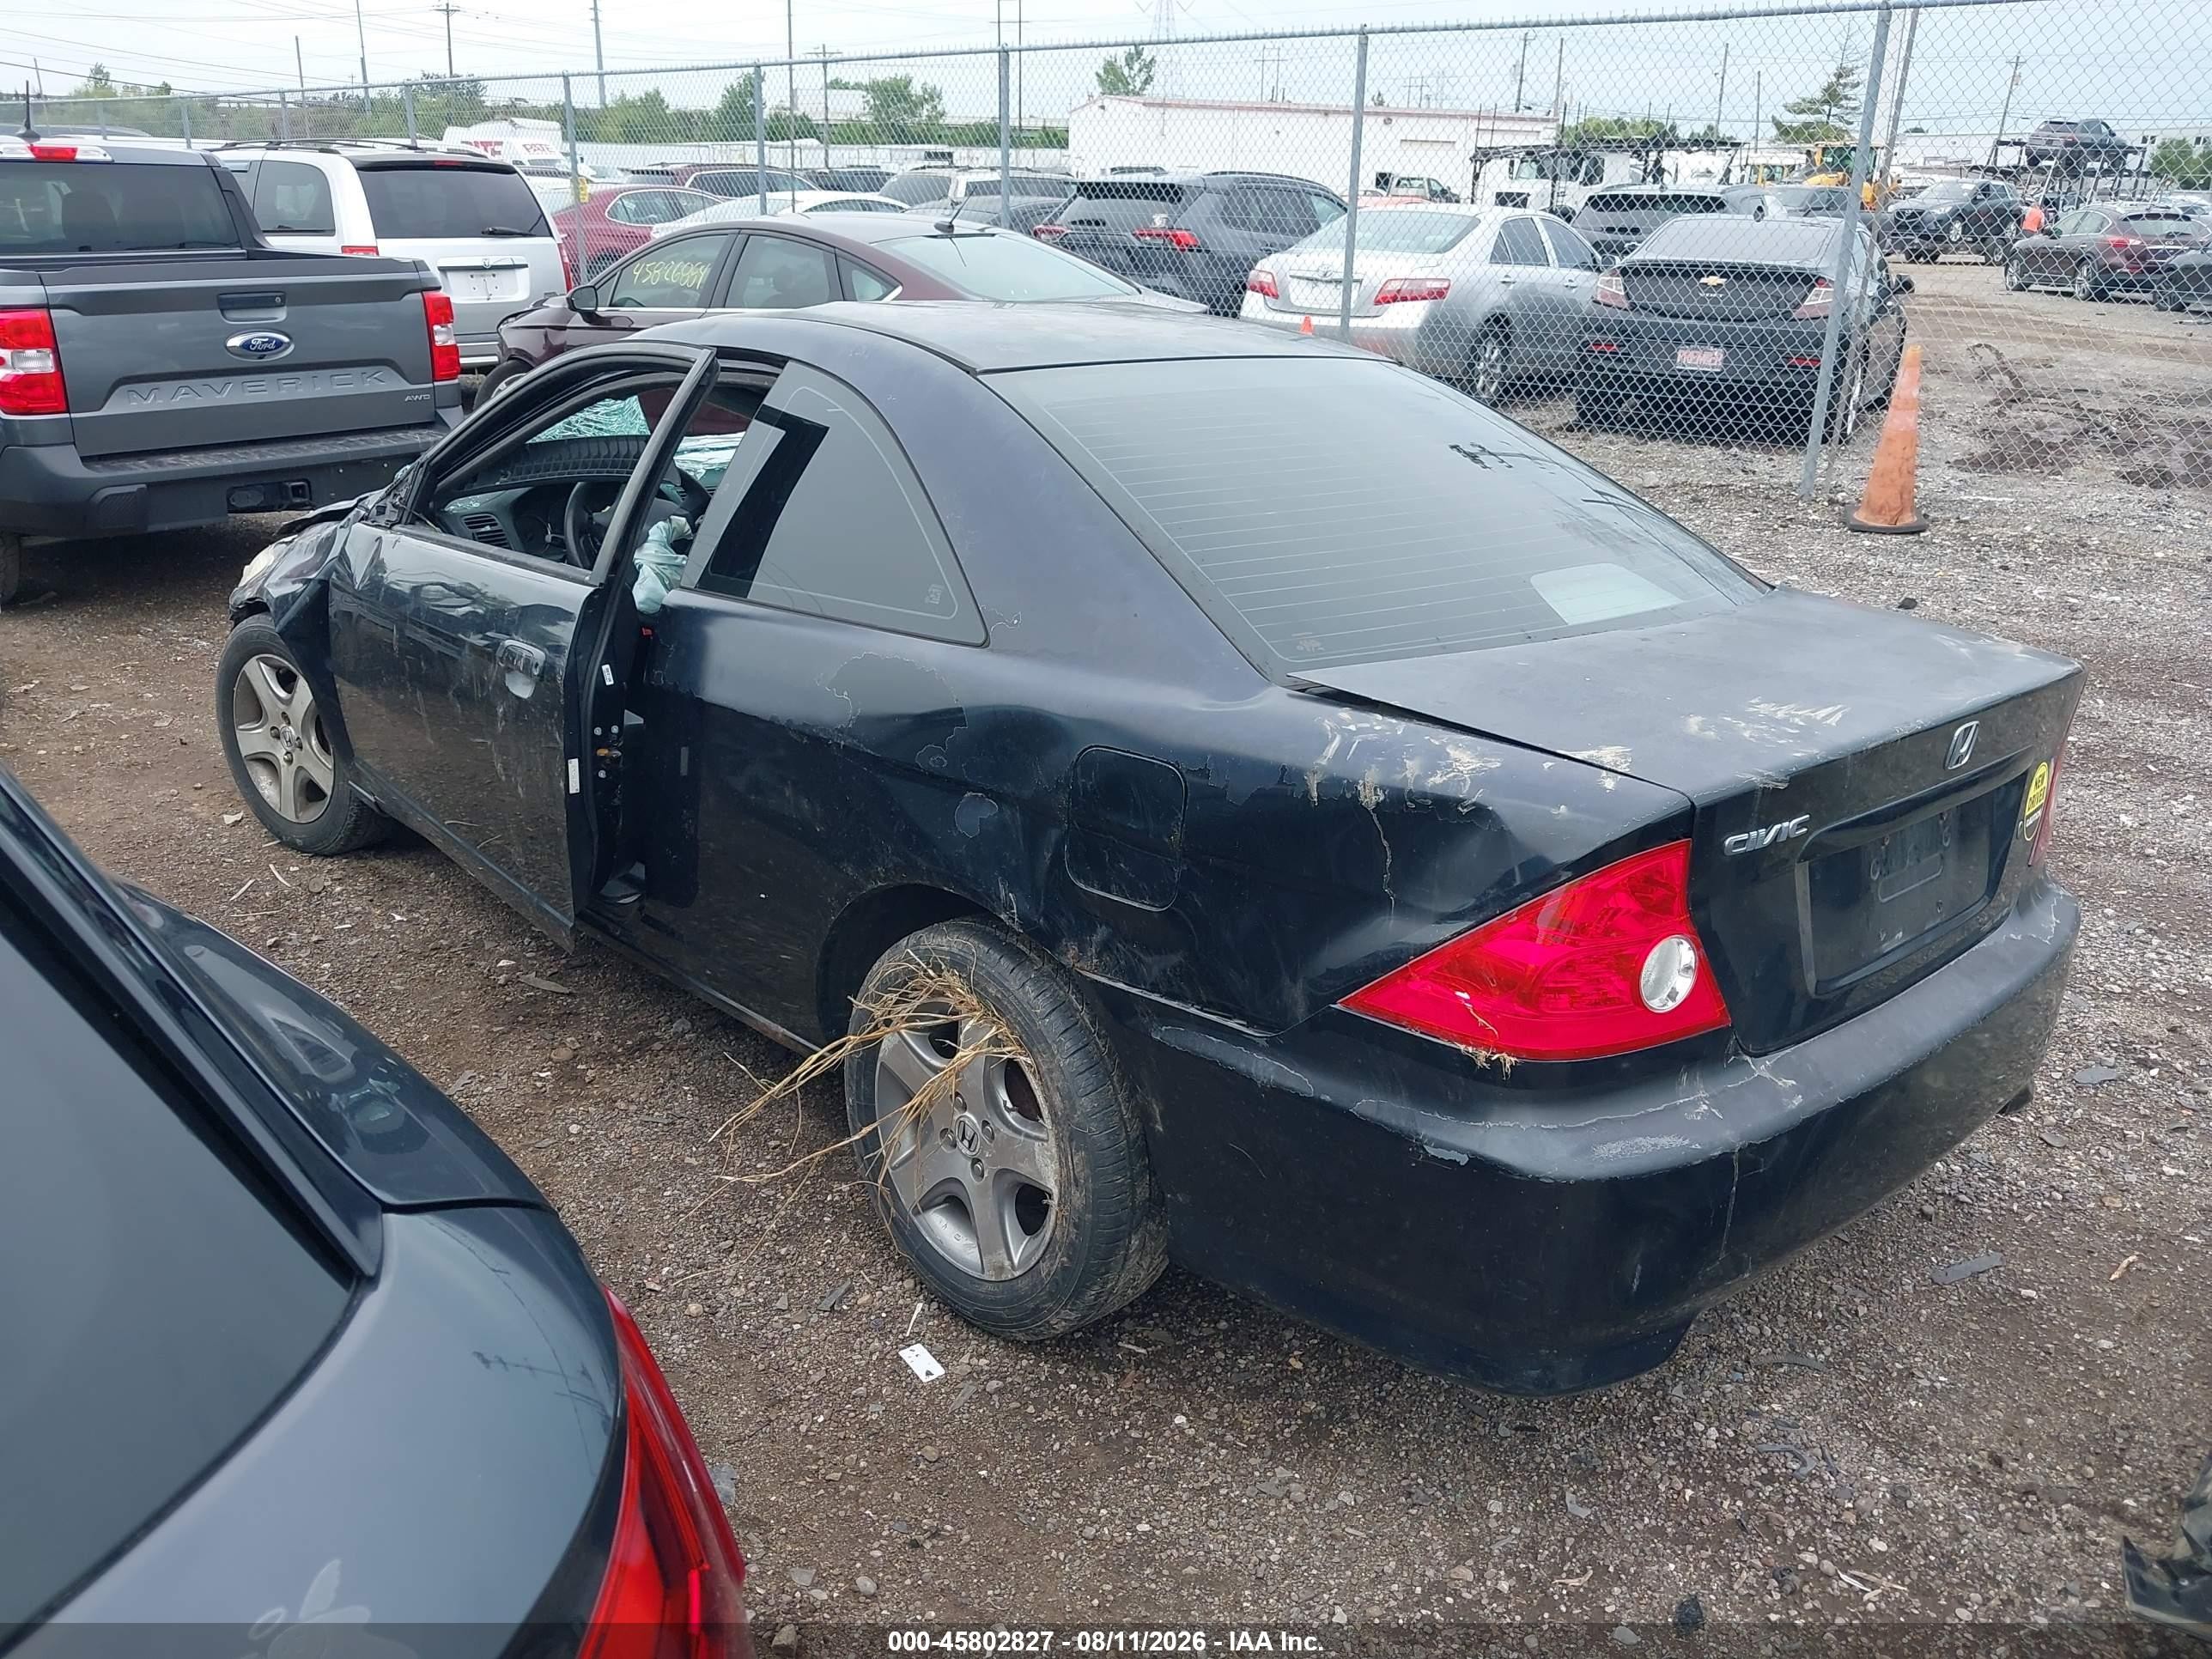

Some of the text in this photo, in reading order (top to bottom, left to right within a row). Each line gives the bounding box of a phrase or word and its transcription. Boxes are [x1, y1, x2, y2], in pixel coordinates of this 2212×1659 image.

[249, 337, 277, 352] Ford
[127, 370, 386, 405] MAVERICK
[404, 393, 431, 403] AWD
[1723, 813, 1810, 856] CIVIC
